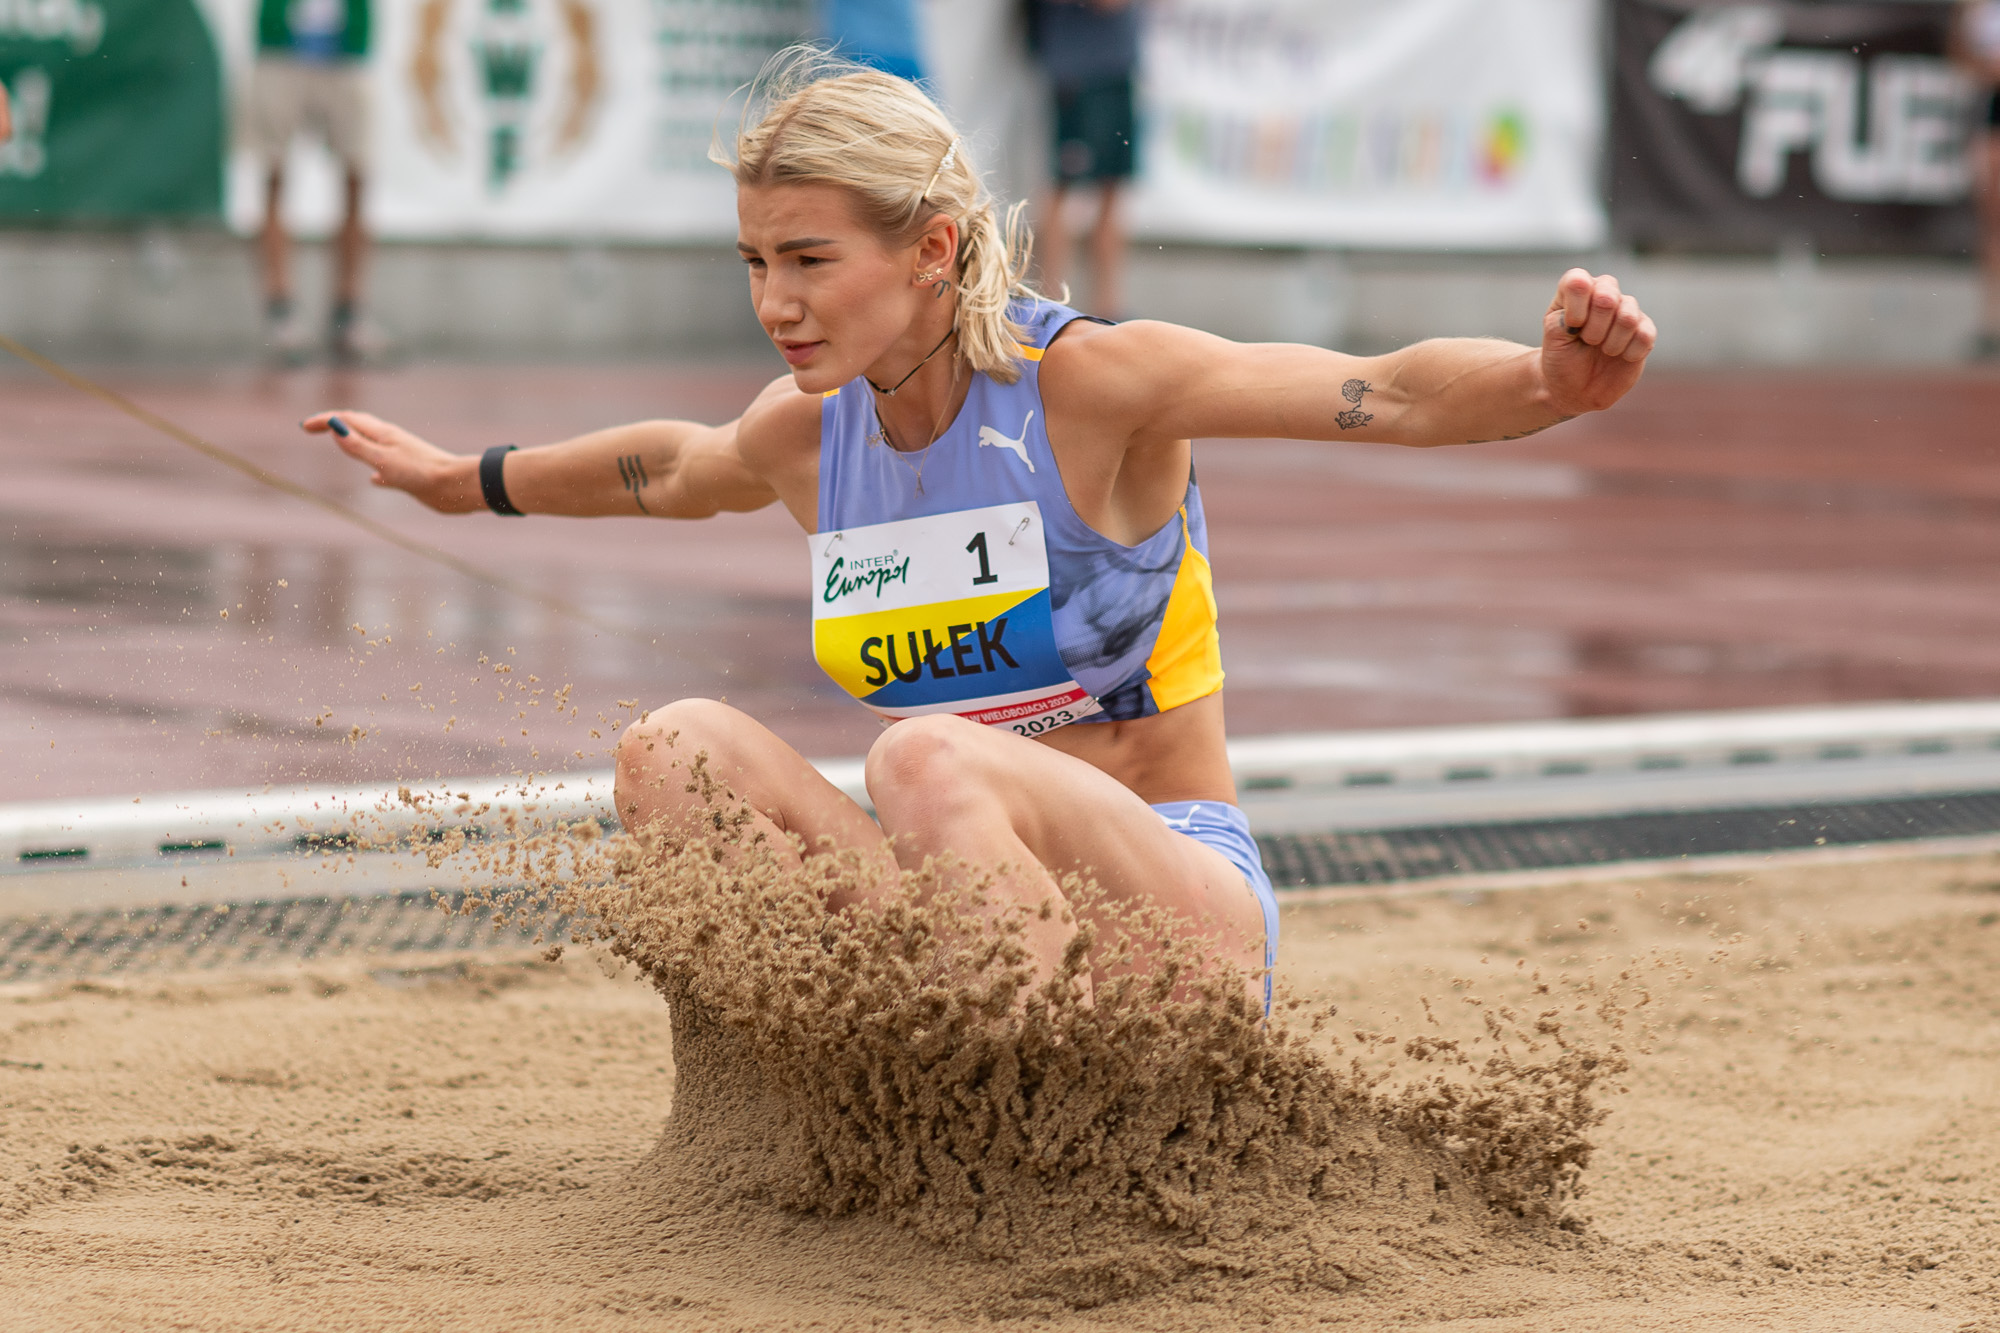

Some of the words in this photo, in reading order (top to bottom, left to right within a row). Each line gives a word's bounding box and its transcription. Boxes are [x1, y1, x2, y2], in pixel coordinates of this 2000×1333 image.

[824, 556, 910, 603] Europol
[965, 531, 998, 585] 1
[860, 618, 1020, 687] SUŁEK
[980, 701, 1049, 722] WIELOBOJACH
[1049, 695, 1072, 708] 2023
[1012, 710, 1074, 737] 2023
